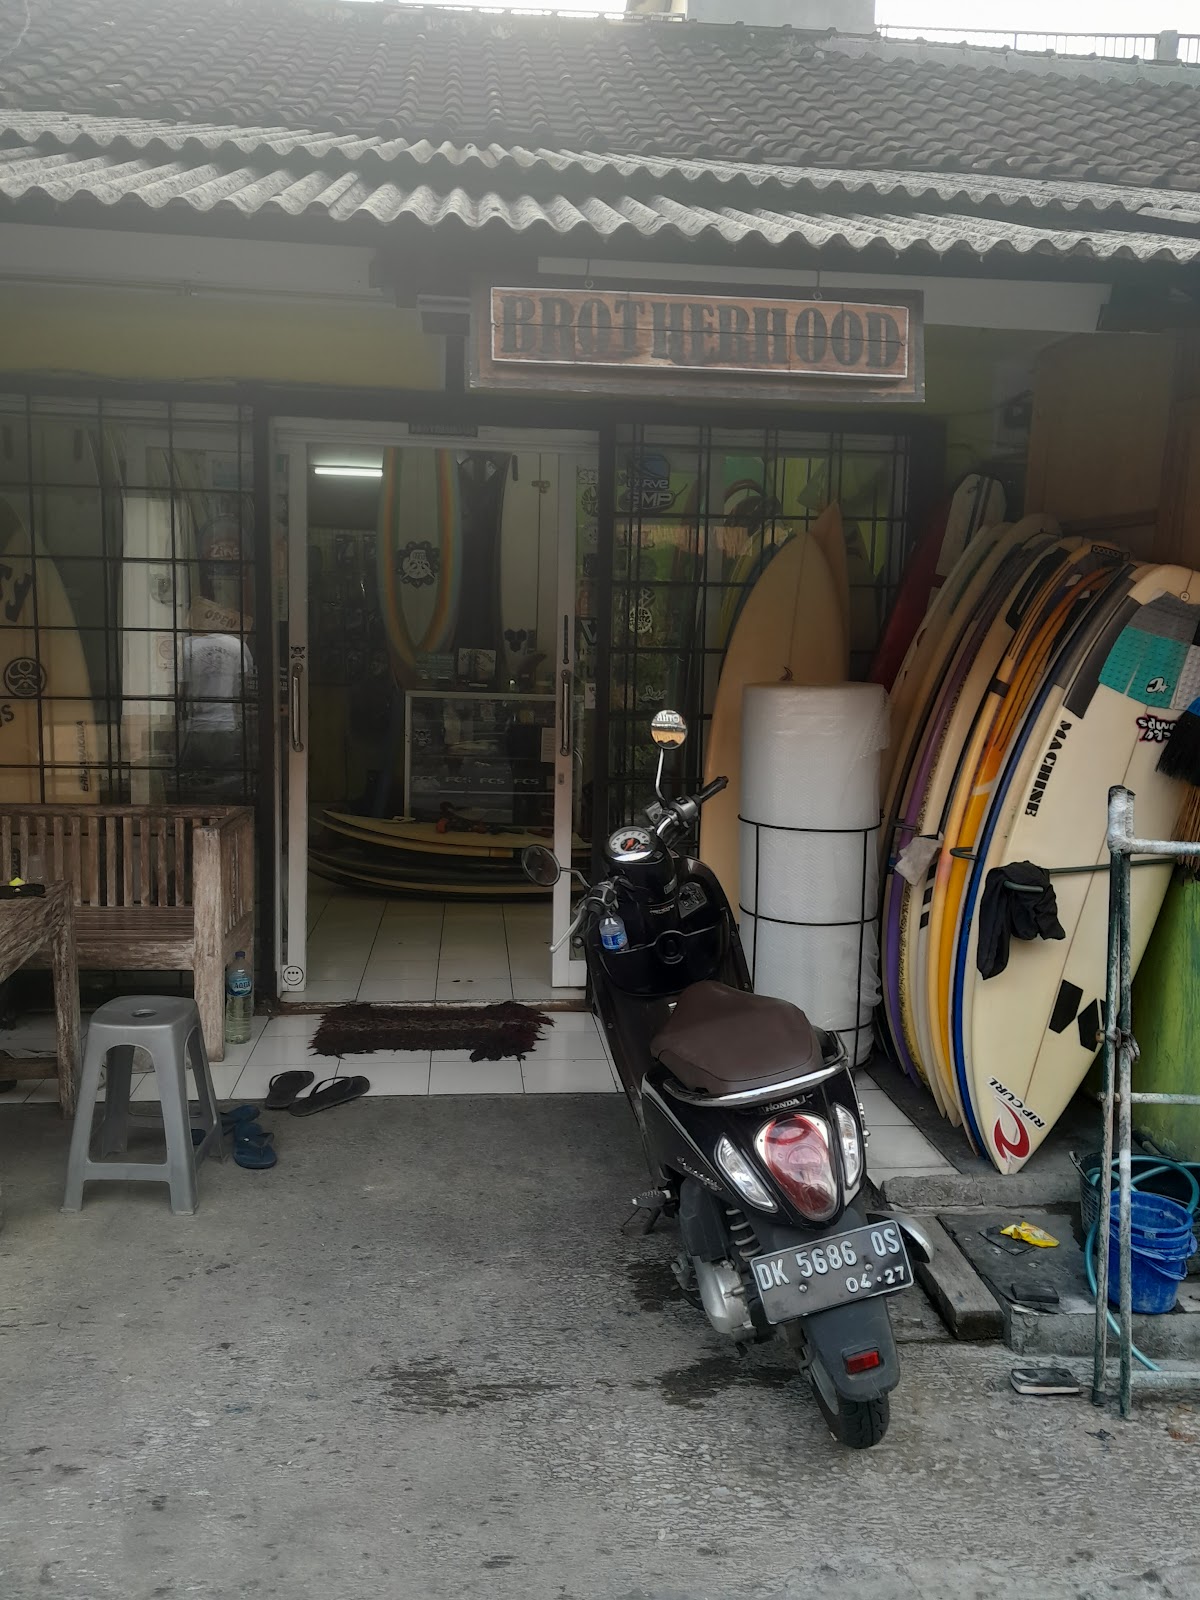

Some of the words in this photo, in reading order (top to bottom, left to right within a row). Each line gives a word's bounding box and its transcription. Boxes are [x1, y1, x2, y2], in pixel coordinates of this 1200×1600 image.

[499, 295, 901, 370] BROTHERHOOD
[204, 609, 237, 629] OPEN
[74, 720, 87, 765] RAKAWA
[479, 777, 506, 785] FCS
[513, 778, 540, 786] FCS
[1024, 719, 1073, 818] MACHINE
[764, 1097, 800, 1113] HONDA
[756, 1258, 790, 1292] DK
[795, 1240, 858, 1279] 5686
